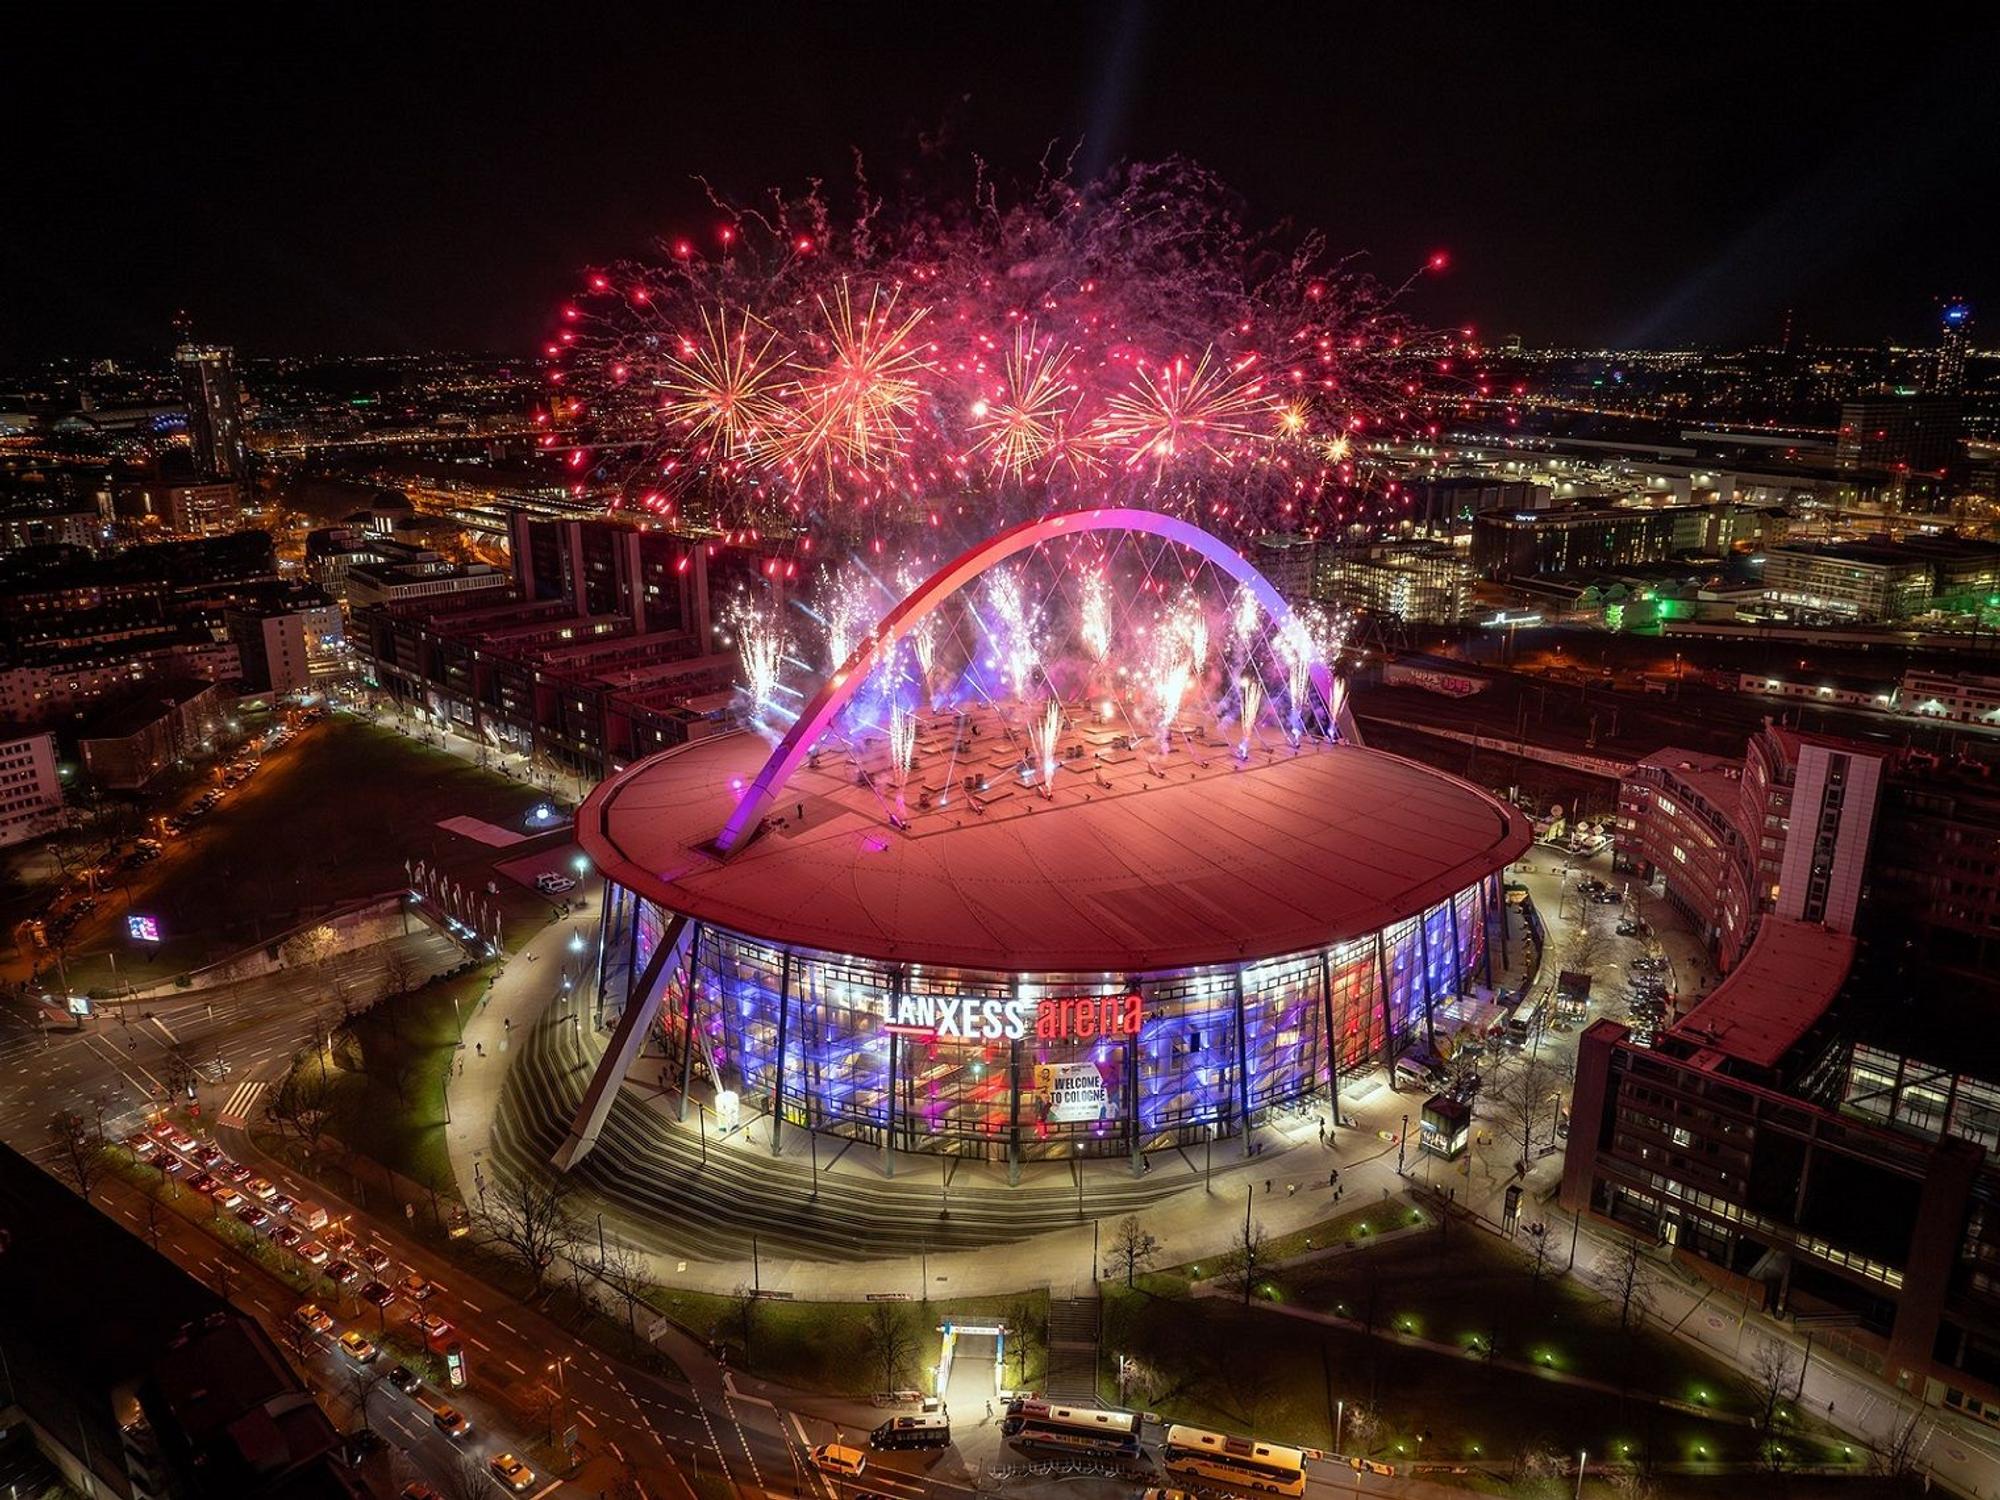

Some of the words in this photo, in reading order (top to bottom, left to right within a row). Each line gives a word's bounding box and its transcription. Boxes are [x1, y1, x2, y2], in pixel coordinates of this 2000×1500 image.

[884, 995, 1024, 1040] LANXESS
[1037, 995, 1142, 1040] arena
[1055, 1076, 1100, 1090] WELCOME
[1050, 1091, 1062, 1104] TO
[1064, 1089, 1105, 1103] COLOGNE
